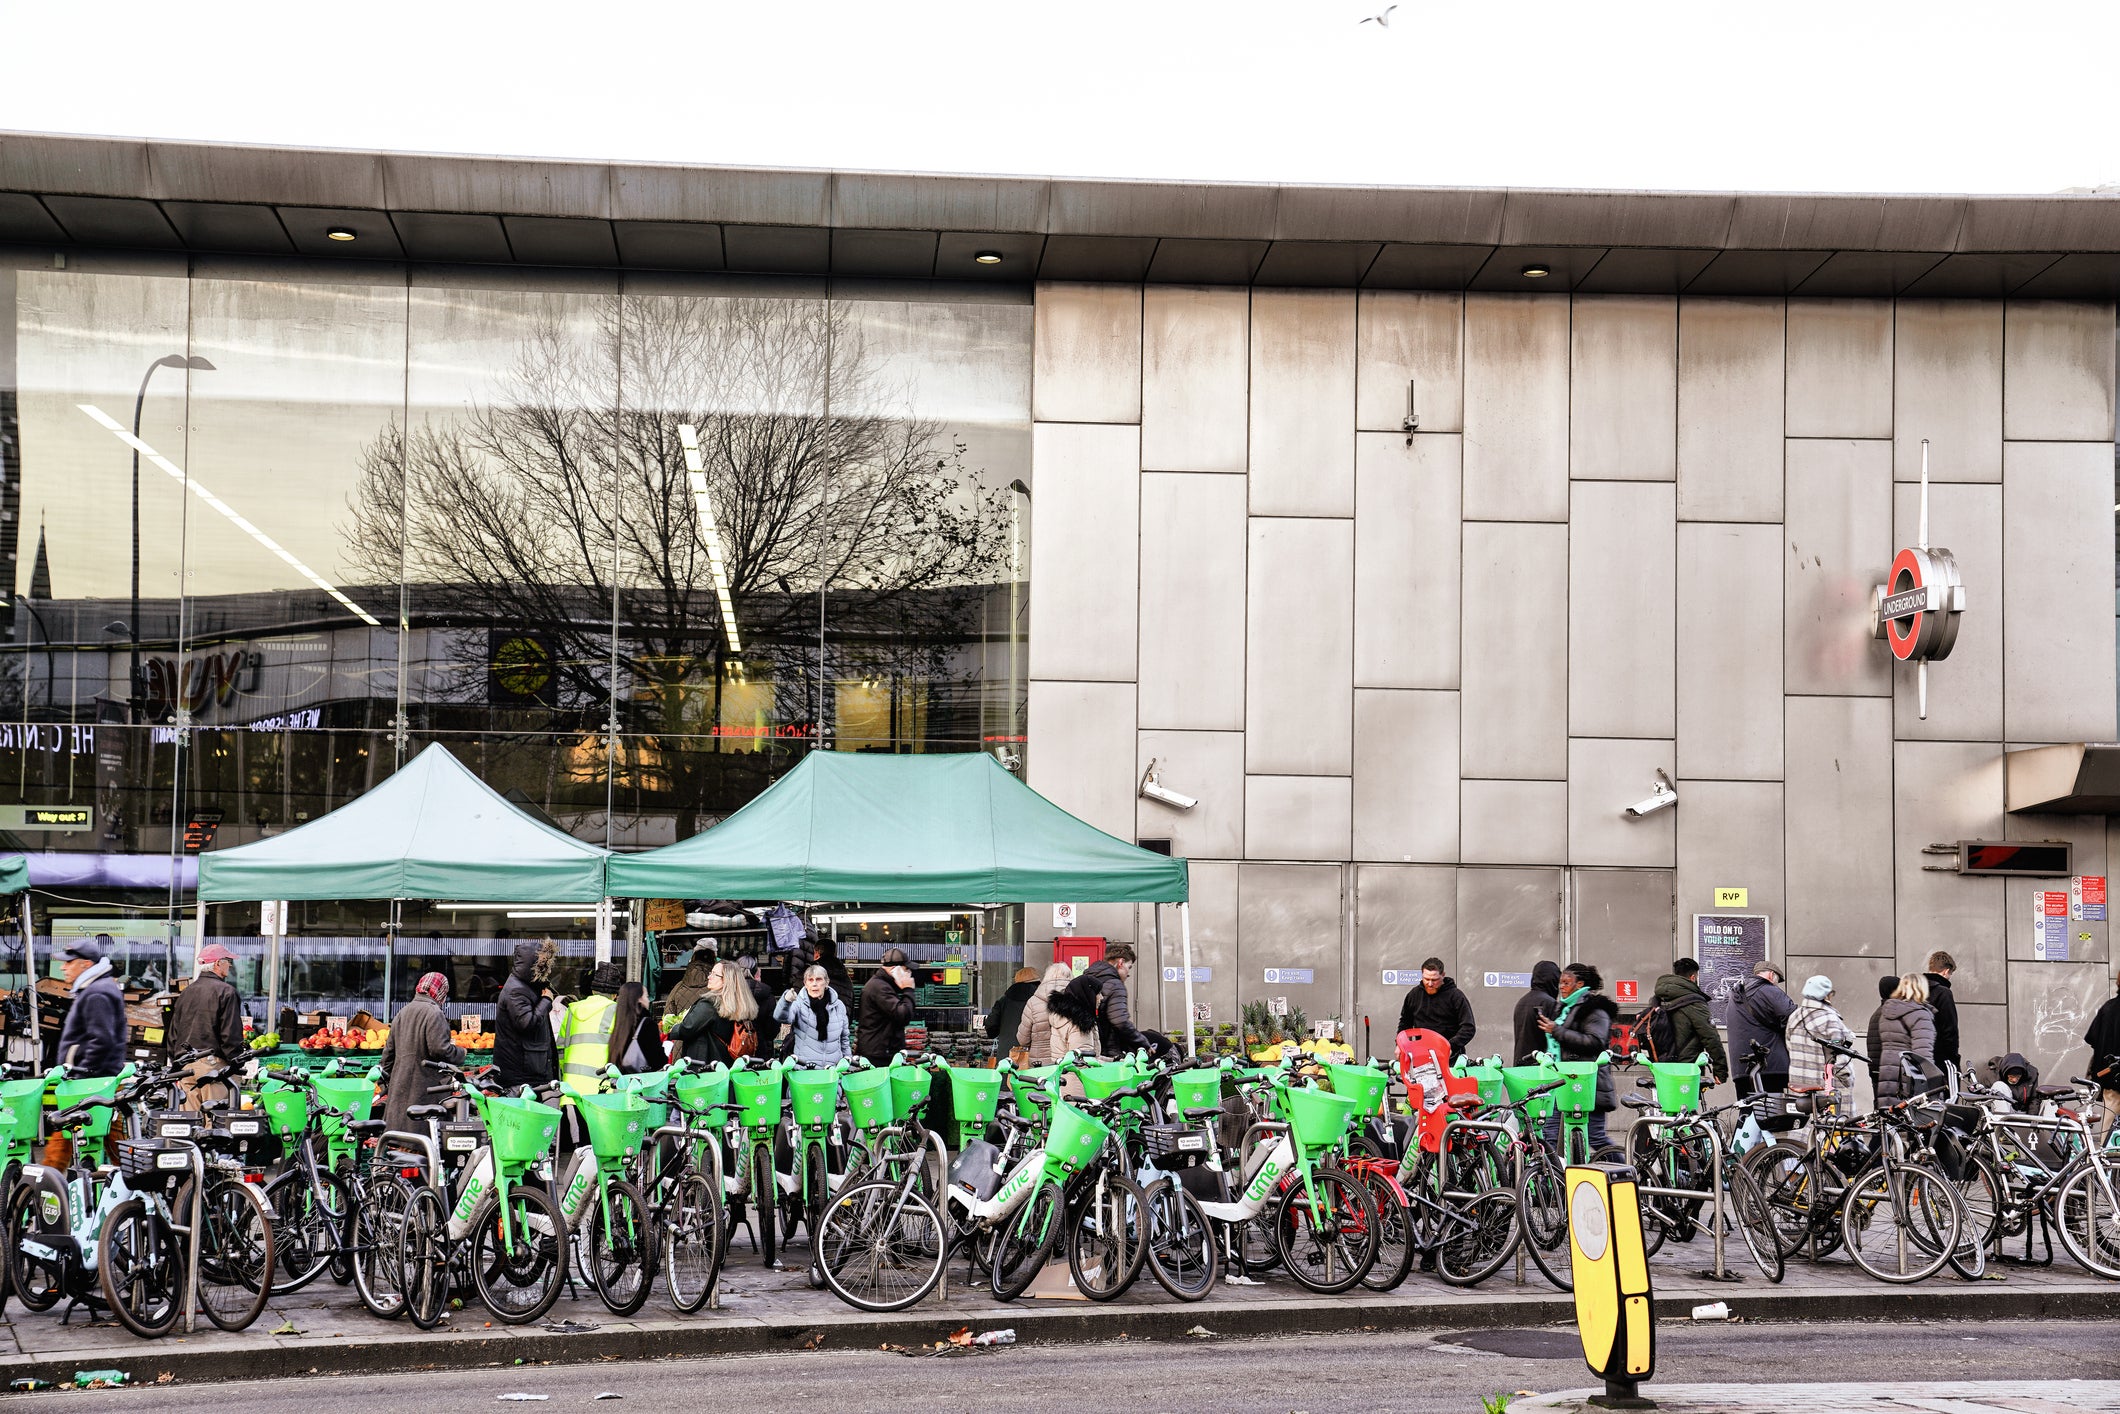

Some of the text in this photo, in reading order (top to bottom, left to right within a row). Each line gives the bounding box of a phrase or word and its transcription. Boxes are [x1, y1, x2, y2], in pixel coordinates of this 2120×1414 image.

[1884, 592, 1926, 616] UNDERGROUND
[36, 812, 76, 823] Way out
[1722, 892, 1740, 900] RVP
[1703, 925, 1743, 935] HOLD ON TO
[1703, 935, 1722, 944] YOUR
[1245, 1161, 1280, 1202] Lime
[454, 1178, 483, 1221] Lime
[561, 1173, 588, 1216] Lime
[70, 1186, 81, 1228] forest
